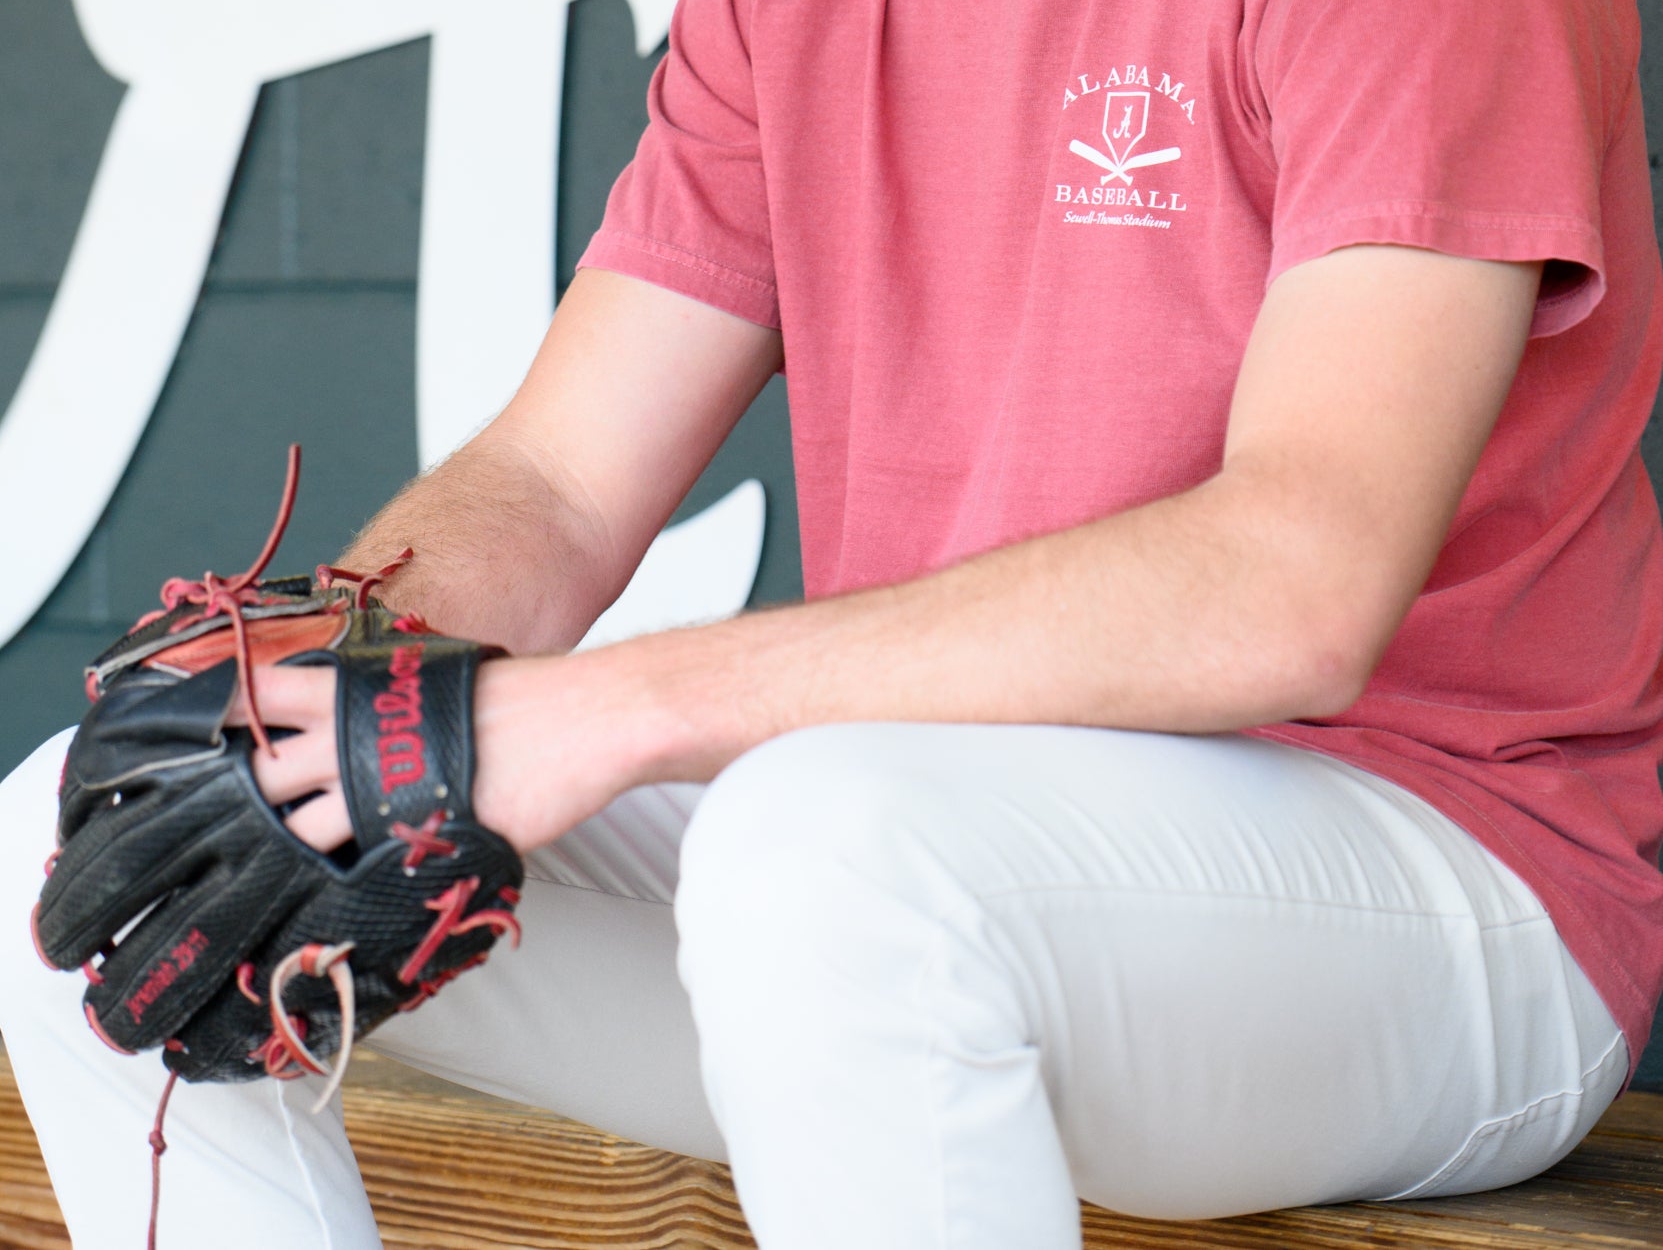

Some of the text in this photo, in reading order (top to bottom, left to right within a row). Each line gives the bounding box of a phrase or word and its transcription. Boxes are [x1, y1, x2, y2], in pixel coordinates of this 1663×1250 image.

[1062, 64, 1196, 123] ALABAMA
[1054, 184, 1188, 212] BASEBALL
[1063, 210, 1172, 229] Sewell-Thomas Stadium
[373, 642, 426, 795] Wilson
